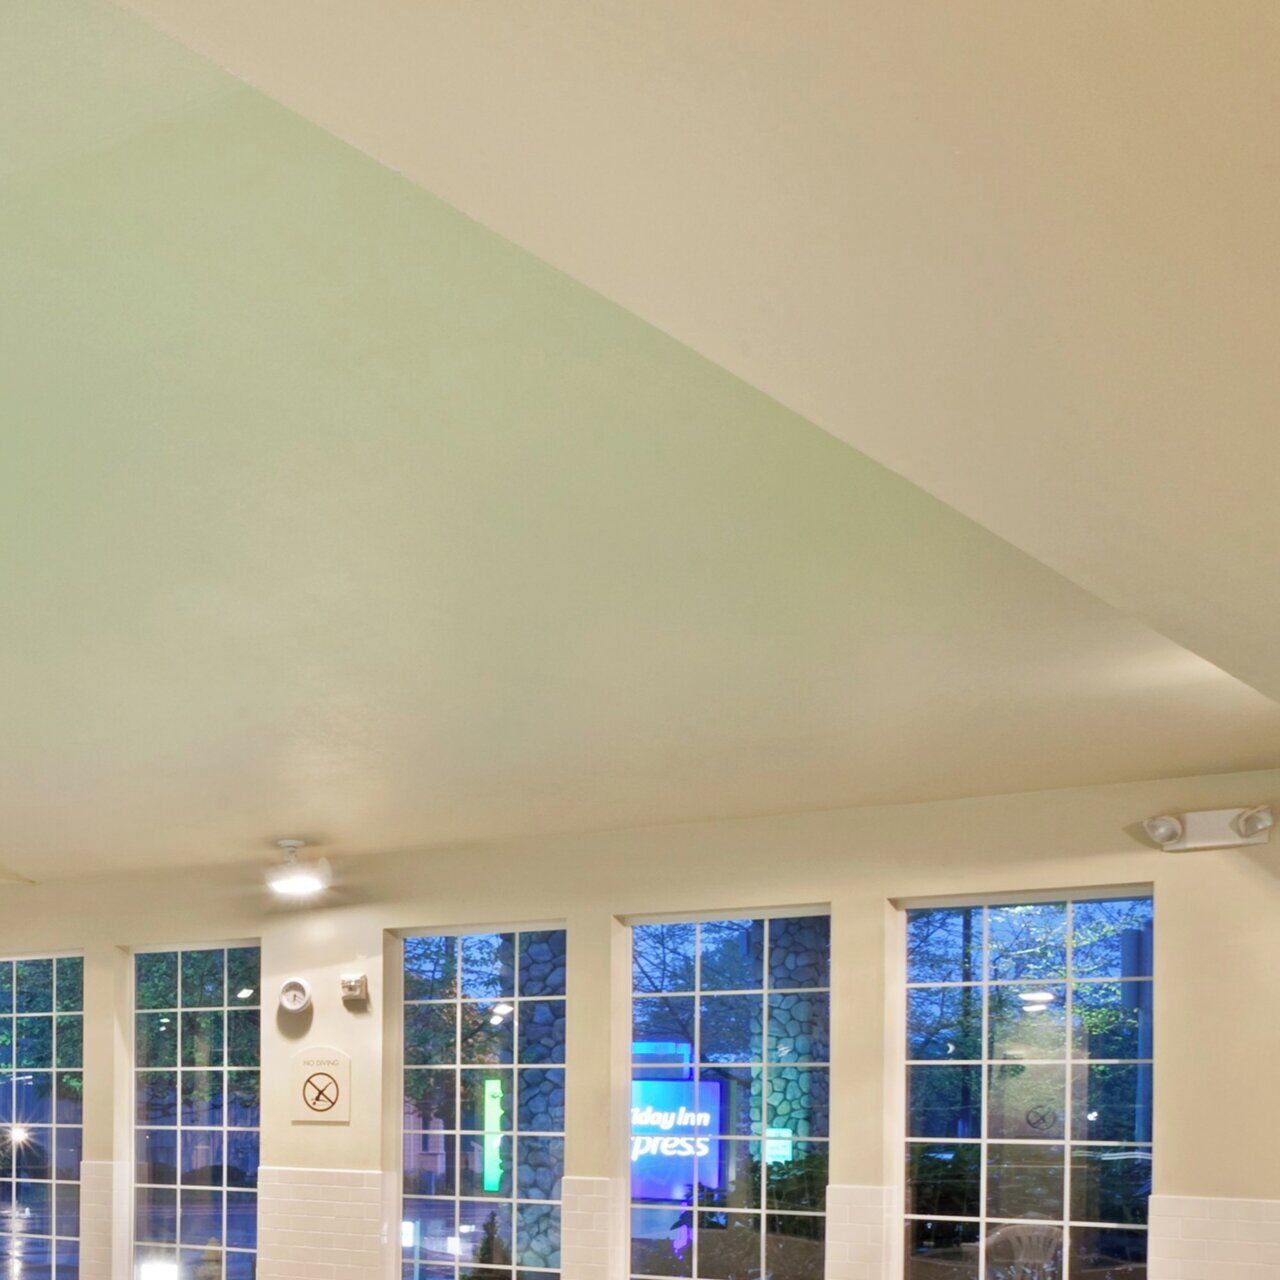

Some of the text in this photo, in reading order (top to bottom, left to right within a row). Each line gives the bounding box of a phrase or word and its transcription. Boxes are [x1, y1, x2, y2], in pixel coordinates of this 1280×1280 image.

[631, 1106, 711, 1130] iday Inn
[631, 1136, 710, 1161] press
